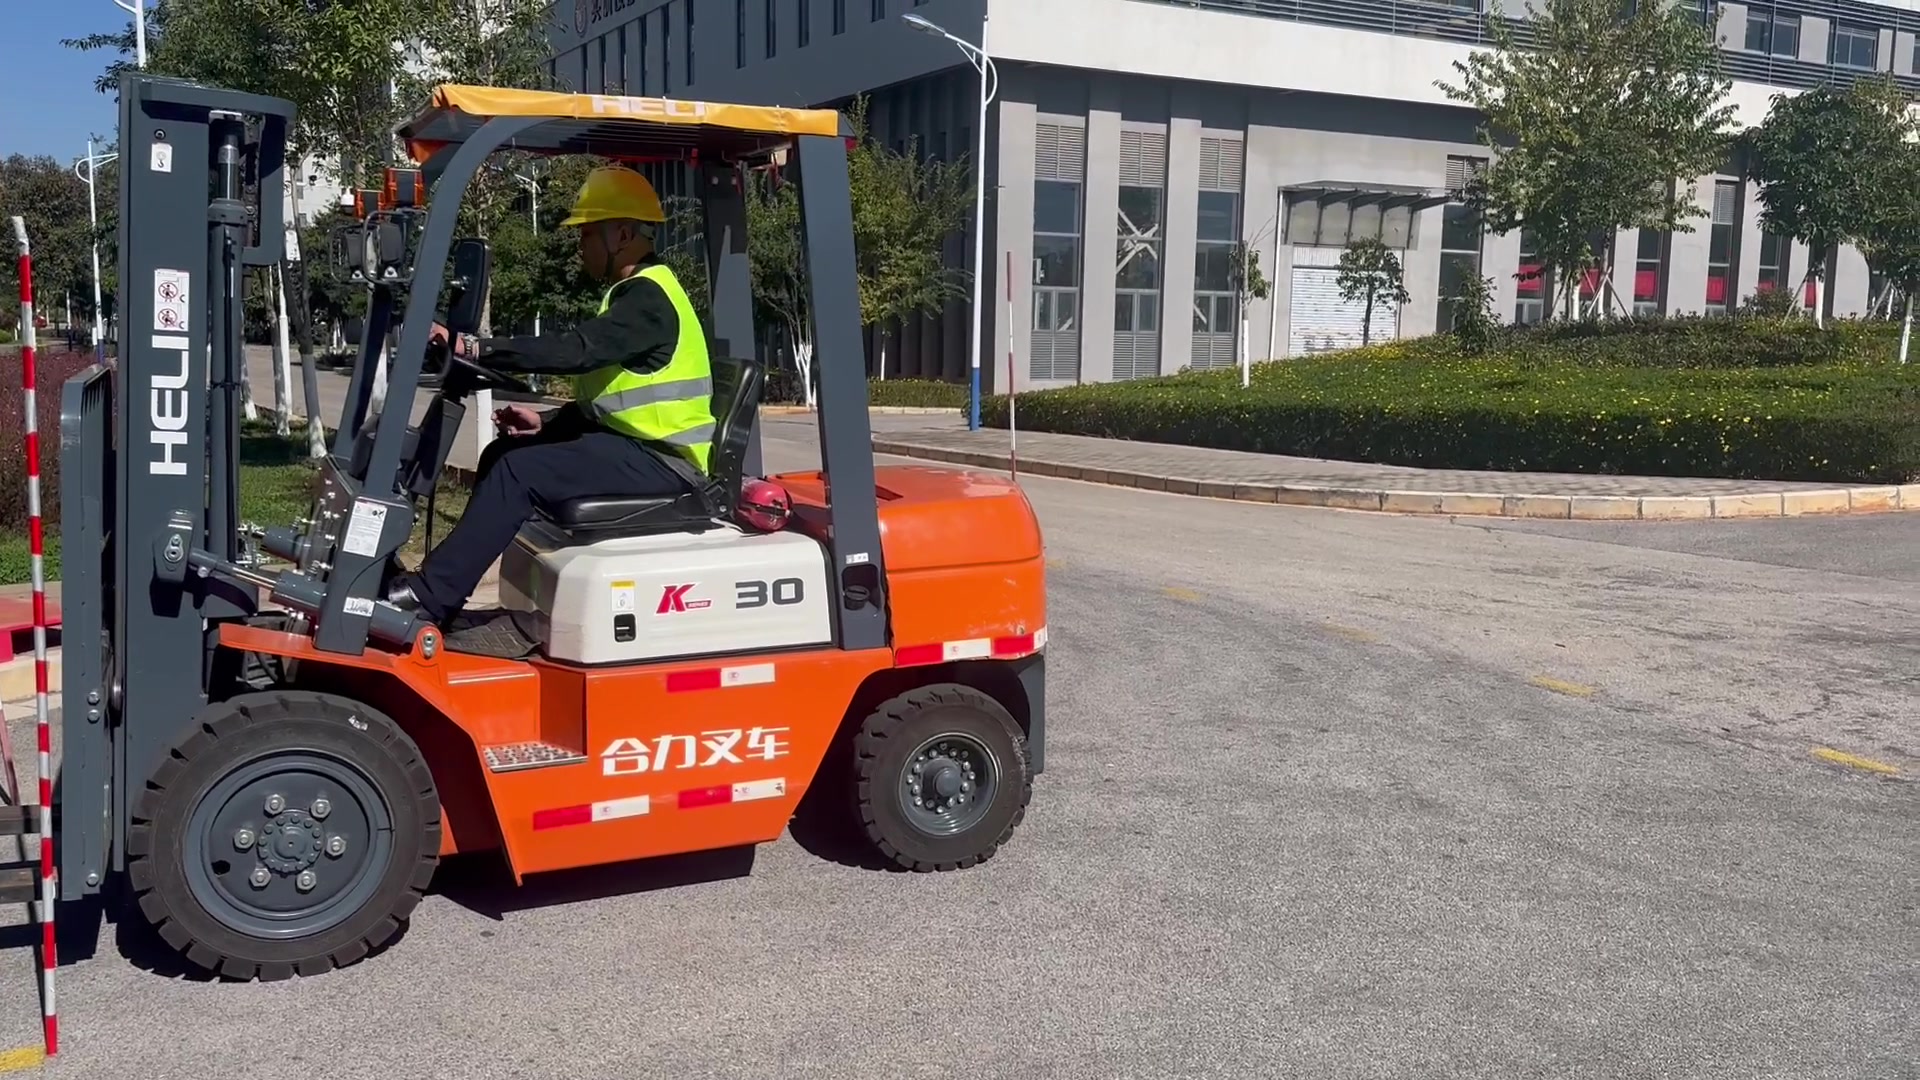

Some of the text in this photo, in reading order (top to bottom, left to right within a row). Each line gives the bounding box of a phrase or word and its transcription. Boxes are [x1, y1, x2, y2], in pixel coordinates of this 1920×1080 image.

[592, 95, 705, 116] HELI
[150, 335, 189, 475] HELI
[656, 583, 696, 614] K
[735, 577, 804, 609] 30
[600, 726, 790, 776] 合力叉车
